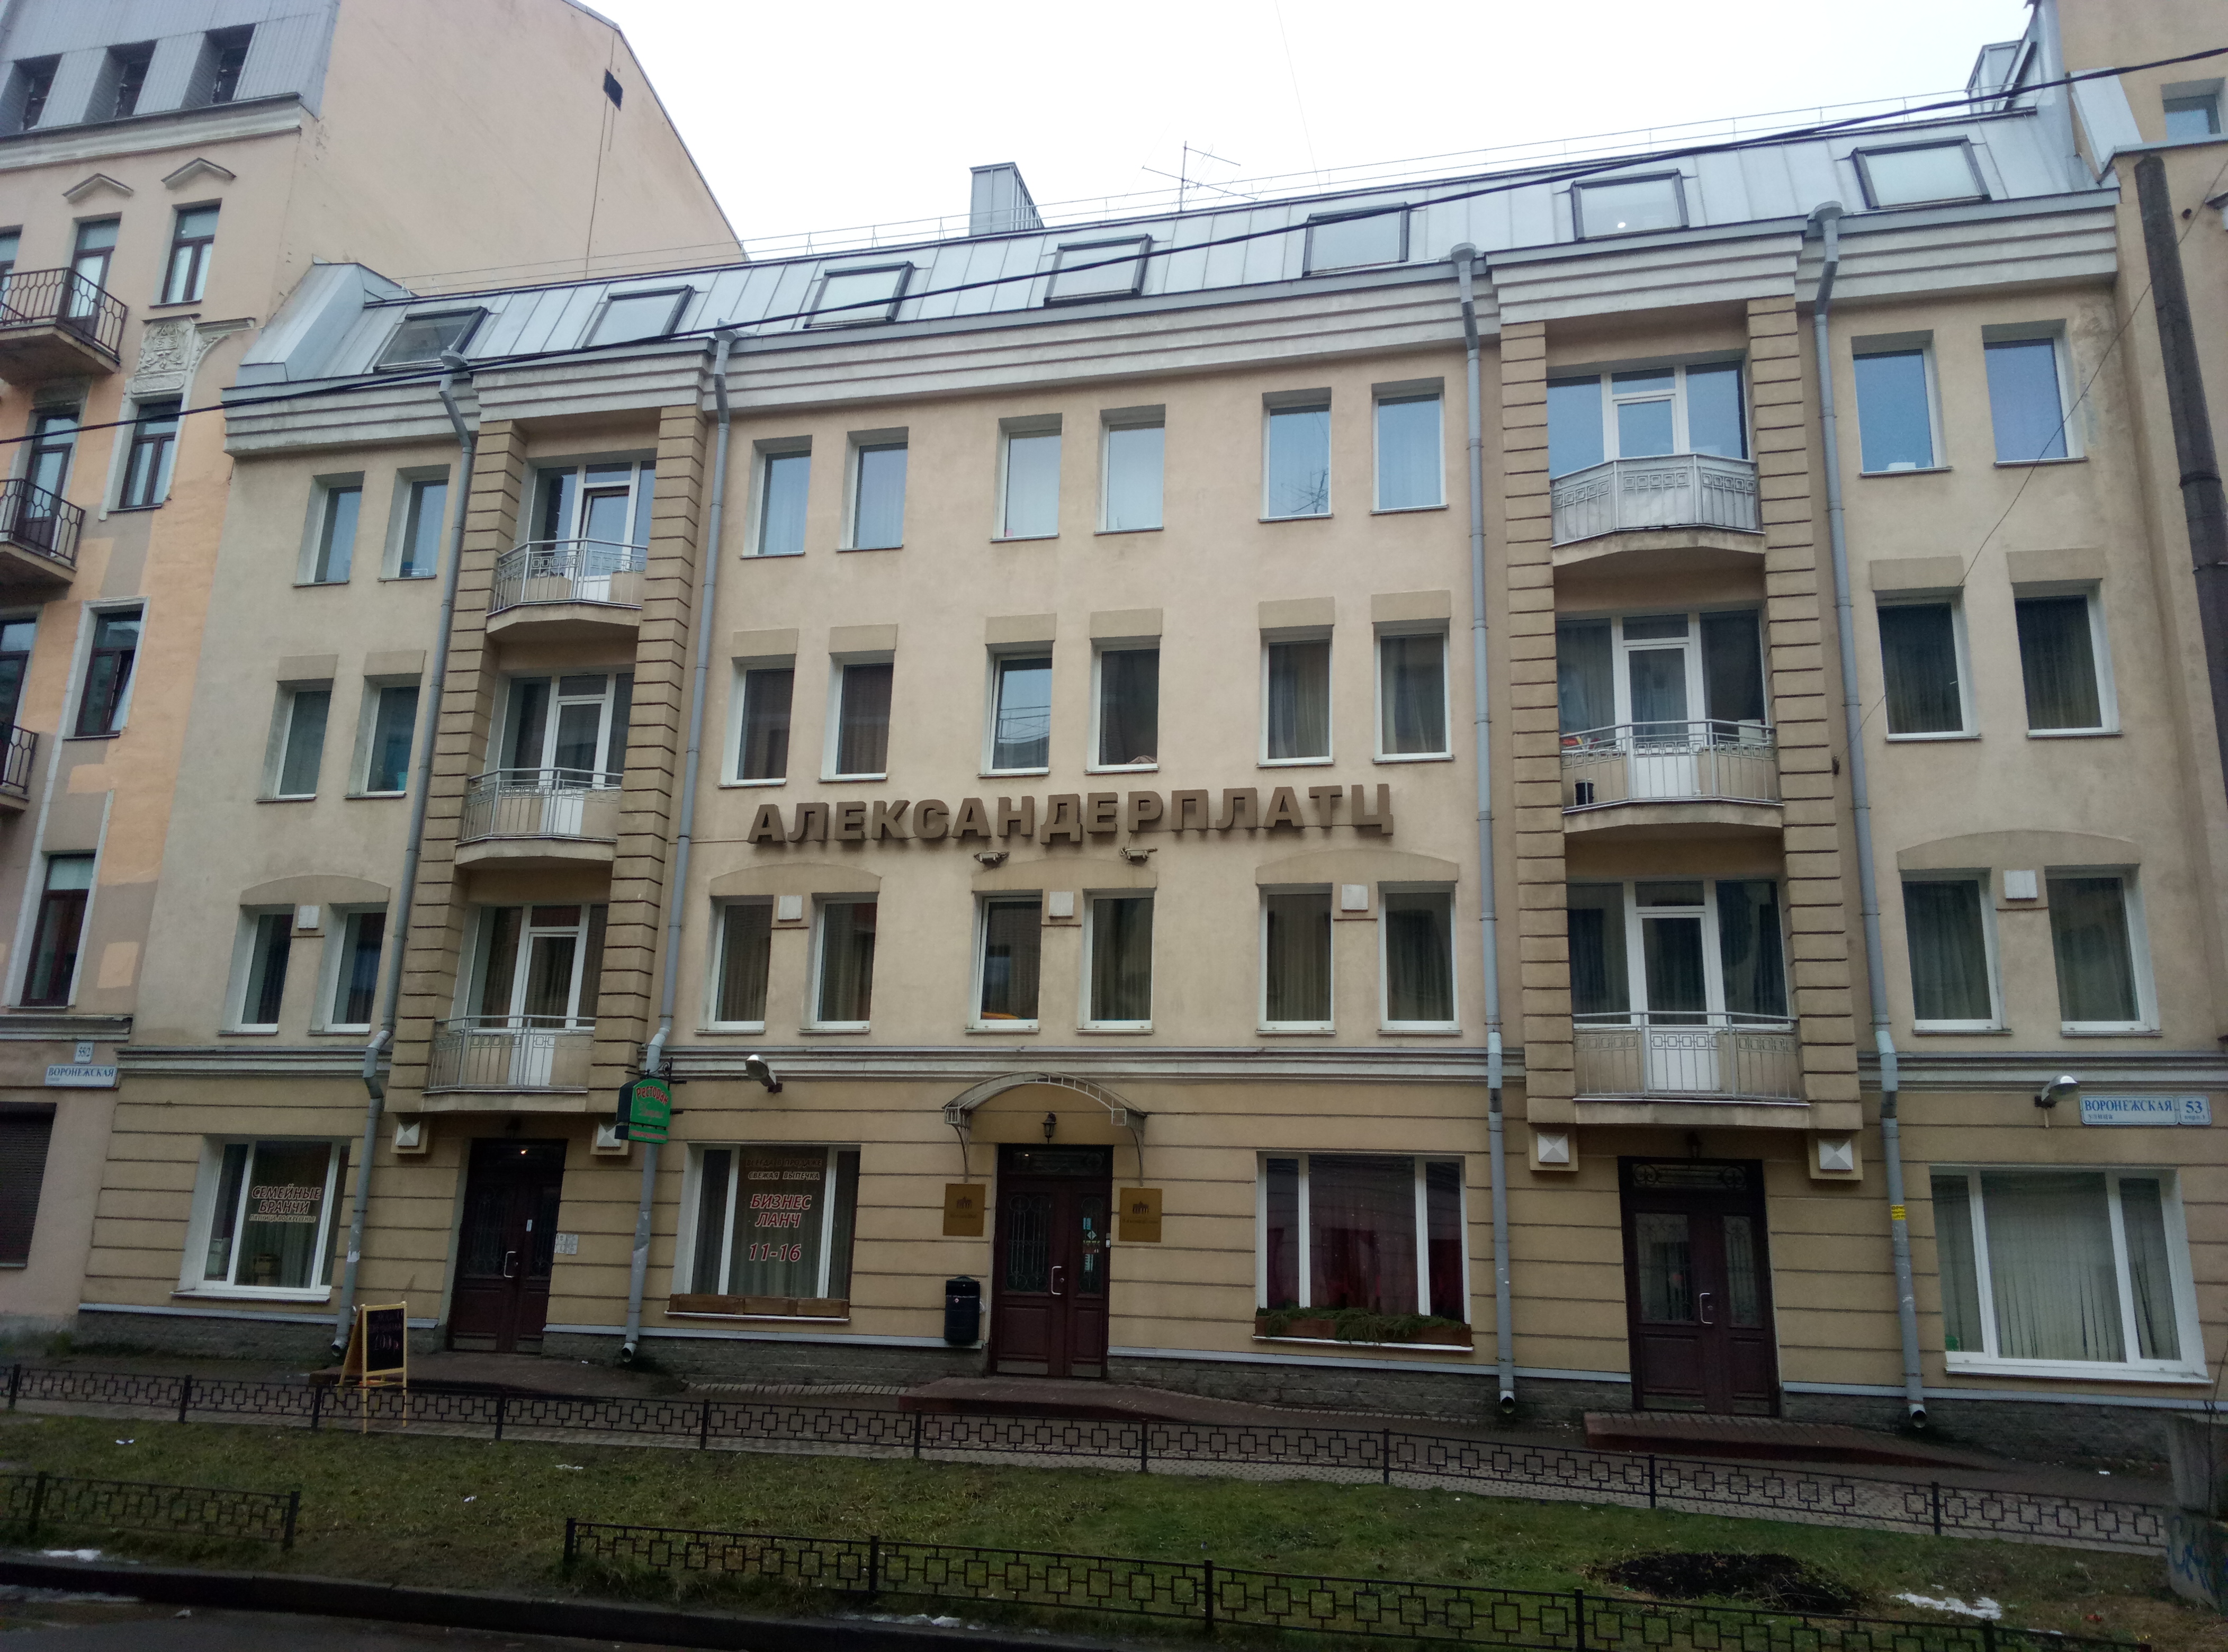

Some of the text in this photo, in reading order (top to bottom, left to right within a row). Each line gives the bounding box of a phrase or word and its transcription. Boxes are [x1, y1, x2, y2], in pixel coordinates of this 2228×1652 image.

[747, 784, 1393, 843] АЛЕКСАНДЕРПЛАТЦ
[48, 1067, 114, 1078] ВОРОНЕЖСКАЯ
[2085, 1100, 2172, 1111] ВОРОНЕЖСКАЯ
[2186, 1101, 2203, 1113] 53
[748, 1171, 821, 1181] СВЕЖАЯ ВЫПЕЧКА
[251, 1183, 322, 1200] СЕМЕЙНЫЕ
[258, 1199, 311, 1215] БРАНЧИ
[750, 1193, 812, 1210] БИЗНЕС
[754, 1212, 802, 1228] ЛАНЧ
[749, 1243, 802, 1262] 11-16
